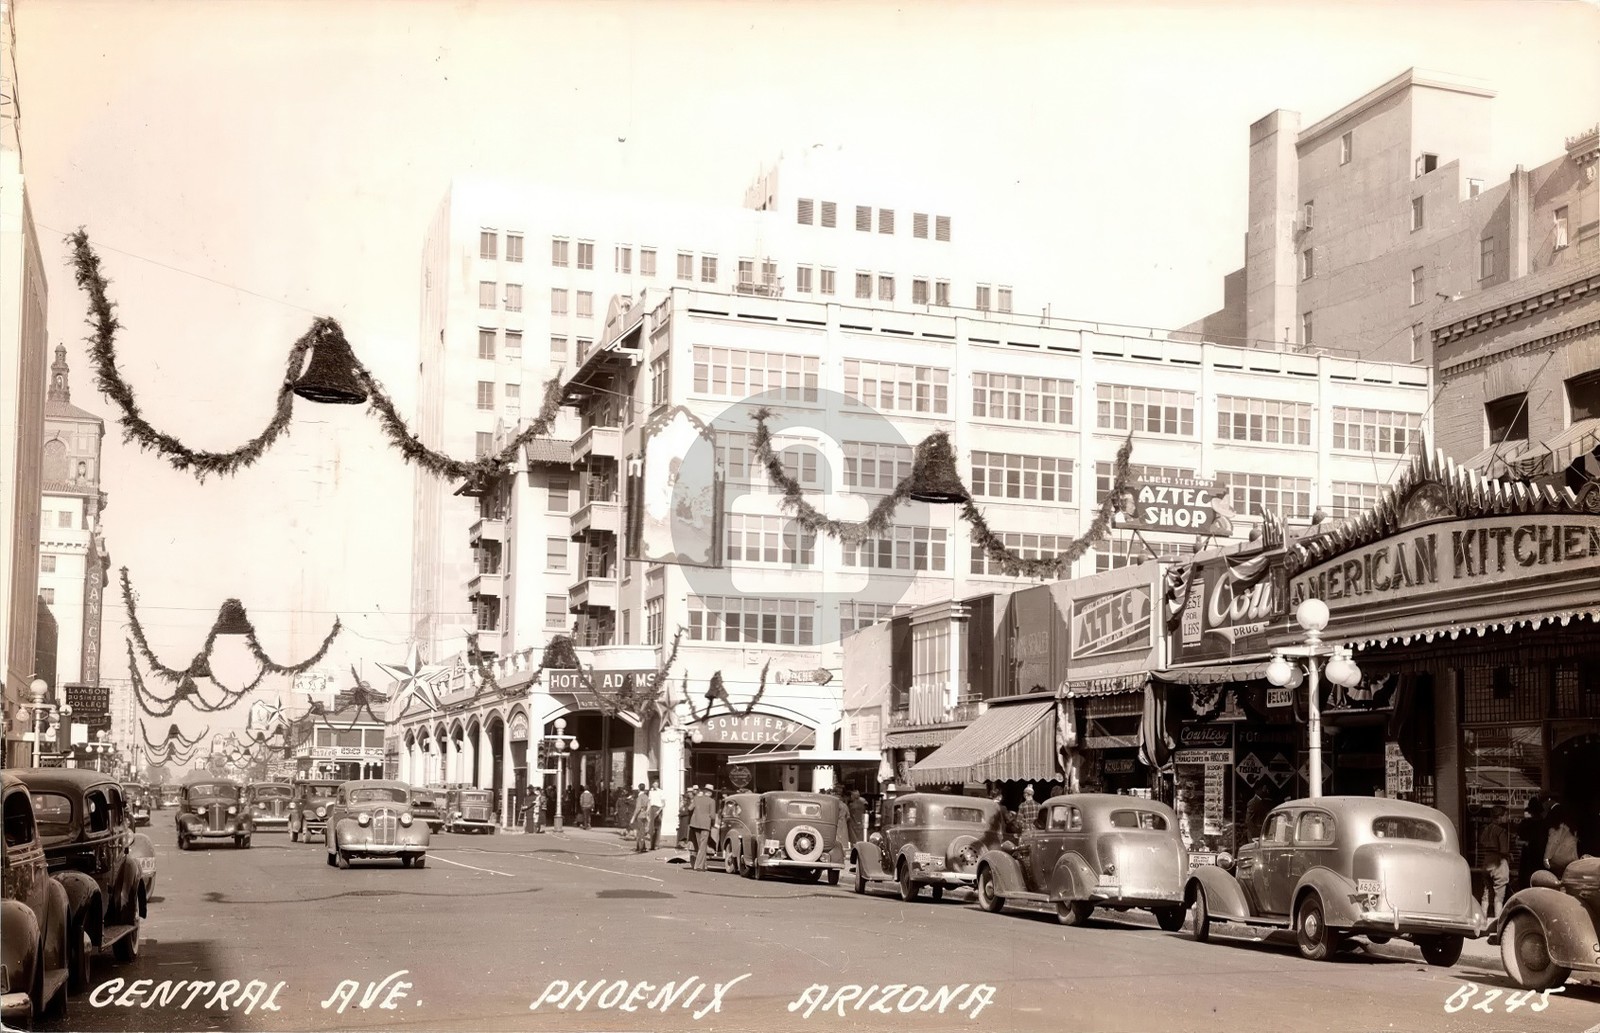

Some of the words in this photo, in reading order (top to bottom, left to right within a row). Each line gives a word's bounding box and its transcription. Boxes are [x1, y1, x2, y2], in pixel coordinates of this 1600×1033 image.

[1137, 475, 1171, 484] ALBERT
[1139, 485, 1212, 508] AZTEC
[1145, 506, 1207, 528] SHOP
[1292, 533, 1438, 605] AMERICAN
[89, 572, 99, 615] SAN
[1079, 591, 1133, 649] AZTEC
[1233, 625, 1259, 637] DRUG
[86, 626, 97, 682] CARL
[603, 673, 656, 688] ADMS
[707, 717, 796, 733] SOUTHERN
[721, 731, 780, 742] PACIFIC
